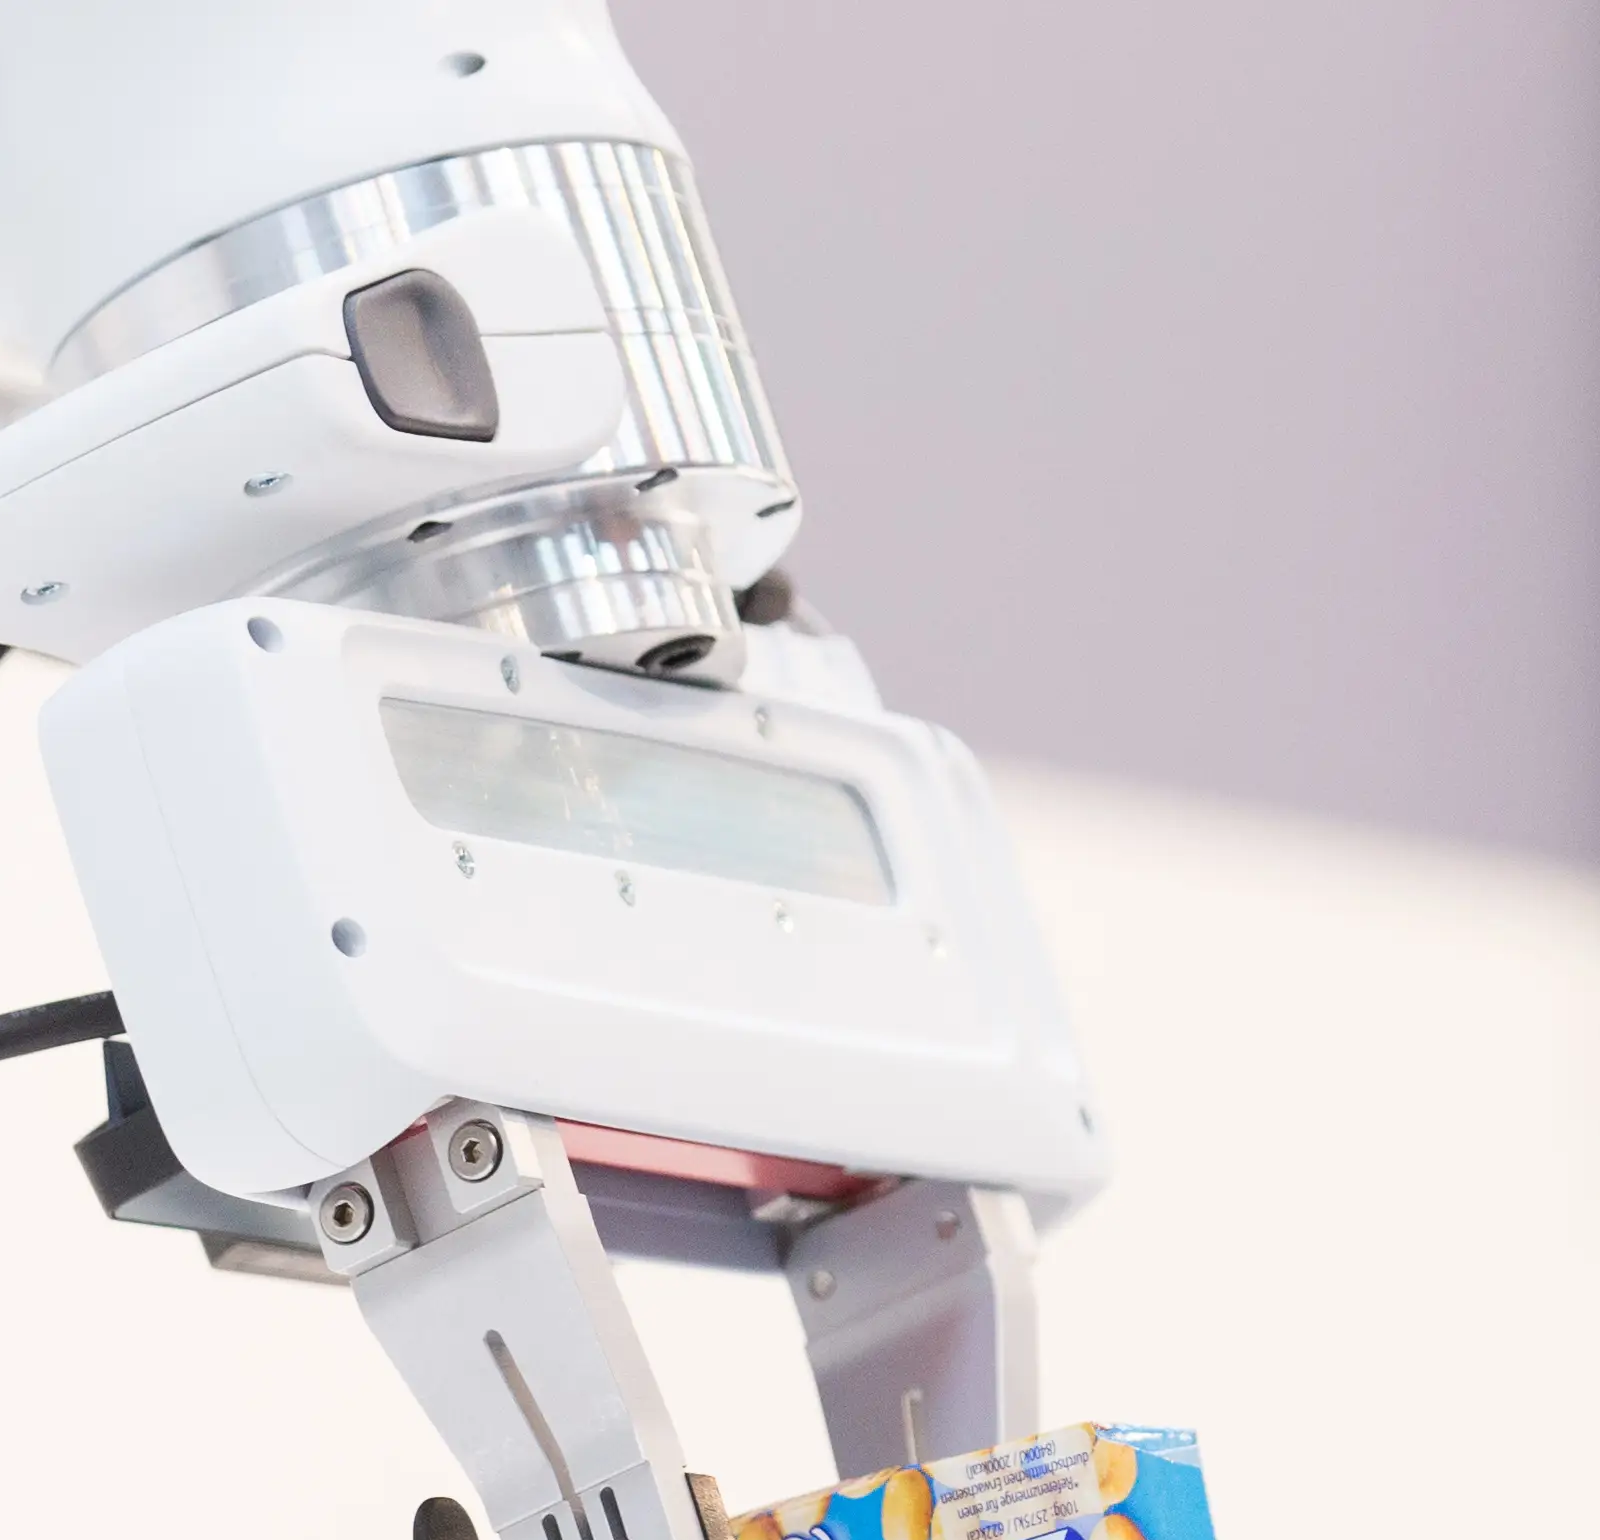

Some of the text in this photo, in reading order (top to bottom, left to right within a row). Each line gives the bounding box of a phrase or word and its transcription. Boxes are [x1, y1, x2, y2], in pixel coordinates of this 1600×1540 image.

[940, 1452, 1090, 1504] durchschnittlichen Erwachsenen
[958, 1502, 984, 1520] einen
[984, 1497, 999, 1512] für
[1052, 1501, 1079, 1518] 100g:
[1013, 1509, 1049, 1532] 2575kJ
